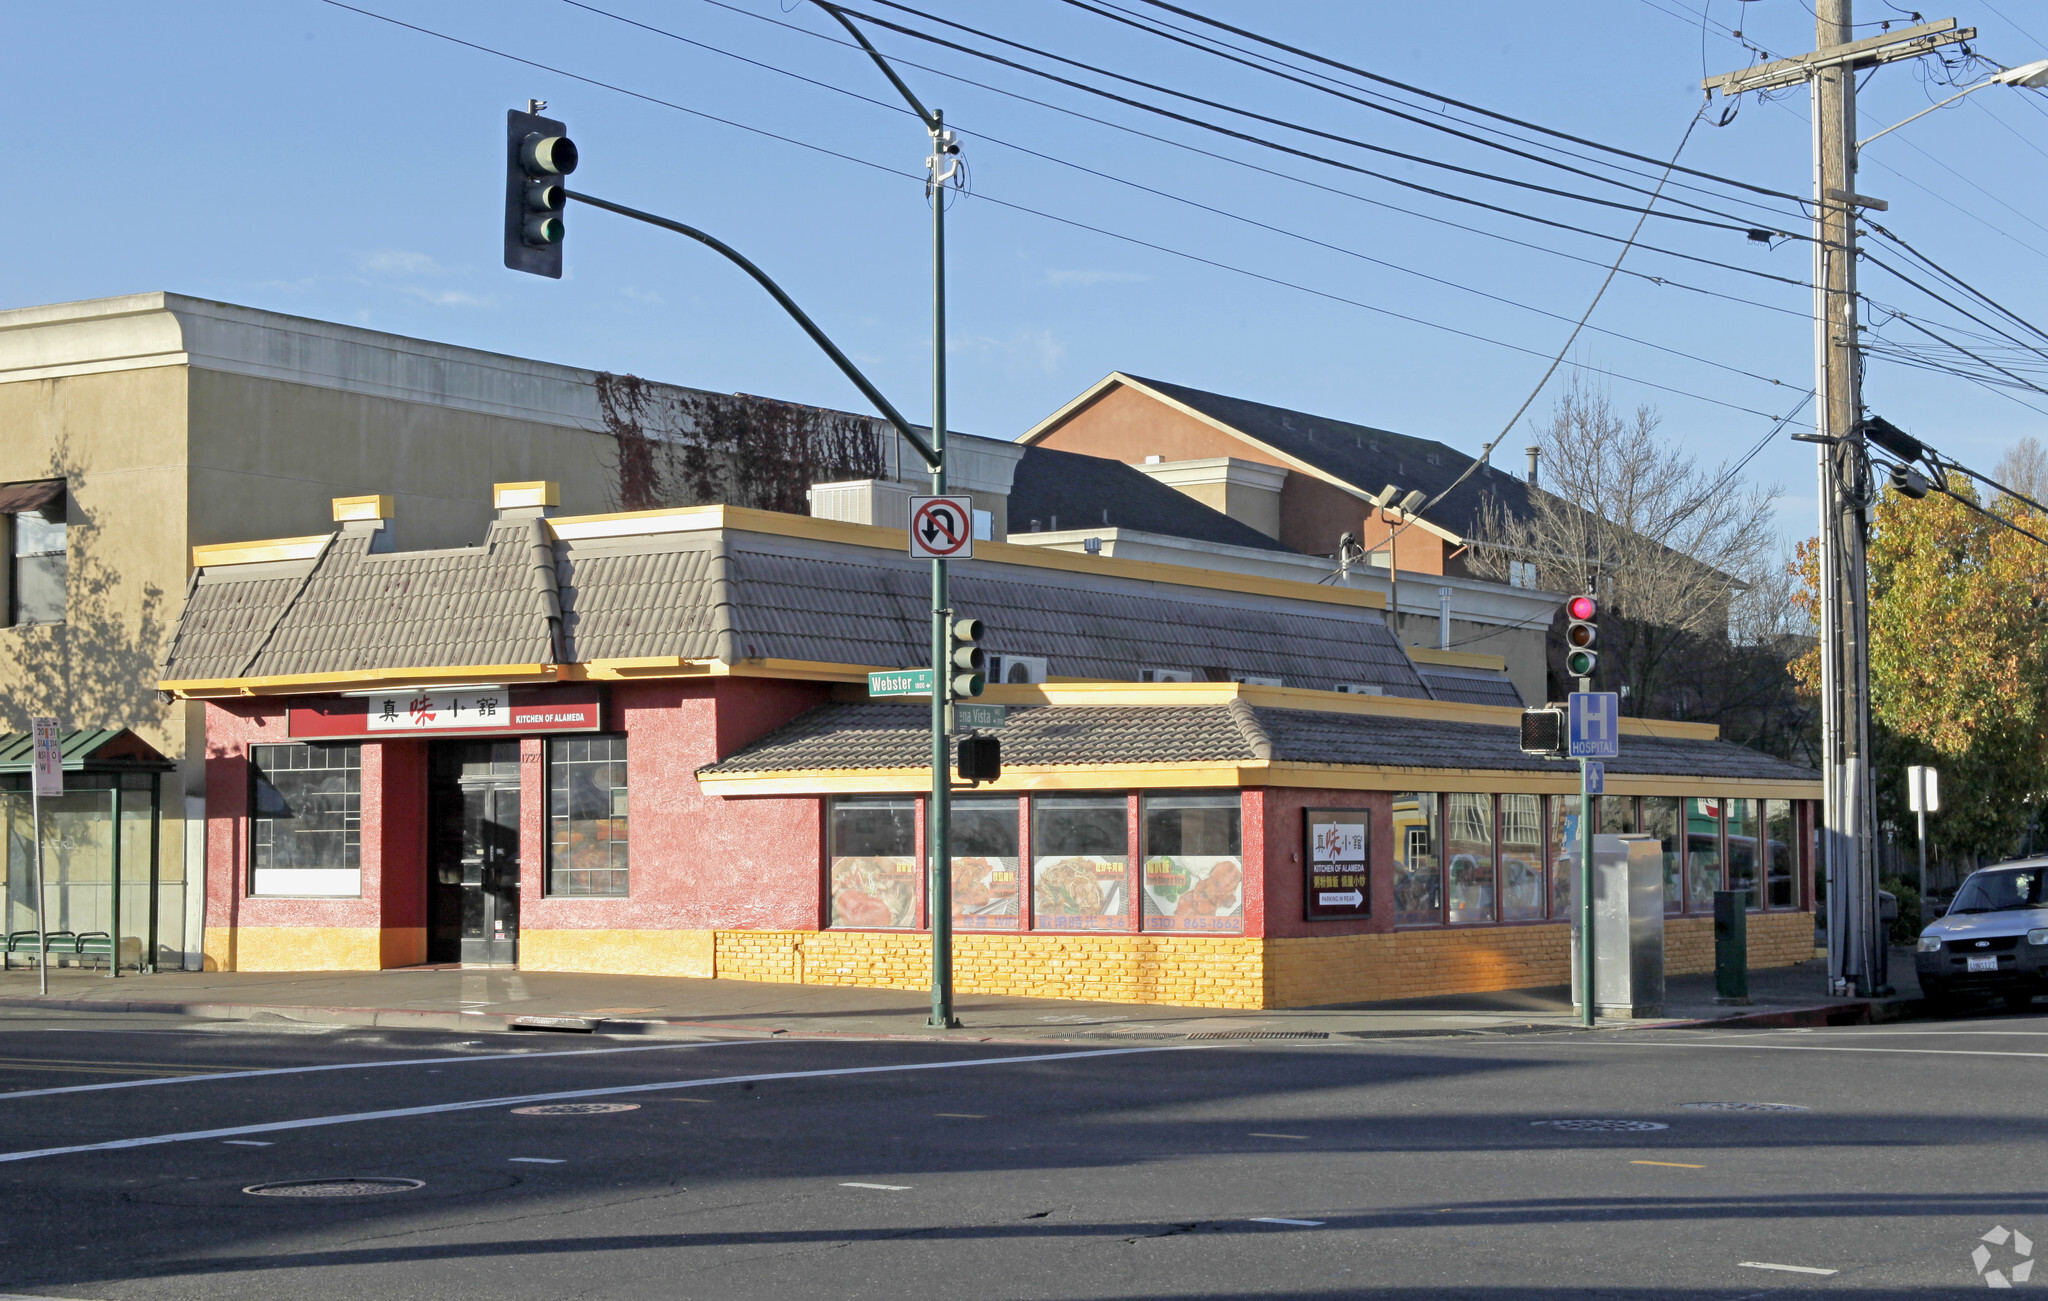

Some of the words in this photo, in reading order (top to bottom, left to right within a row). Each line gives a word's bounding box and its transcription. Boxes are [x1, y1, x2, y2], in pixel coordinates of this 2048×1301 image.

[872, 676, 912, 692] Webster
[515, 714, 544, 724] KITCHEN
[545, 714, 553, 722] OF
[554, 713, 585, 722] ALAMEDA
[973, 708, 991, 724] Vista
[1580, 695, 1607, 739] H
[37, 727, 44, 736] 20
[50, 727, 56, 736] 31
[37, 739, 46, 748] 51A
[1572, 741, 1615, 754] HOSPITAL
[1313, 865, 1334, 873] KITCHEN
[1334, 864, 1341, 872] OF
[1342, 864, 1365, 872] ALAMEDA
[1106, 917, 1126, 928] 3-6
[1146, 917, 1176, 929] (510)
[1184, 917, 1240, 930] 865-1662
